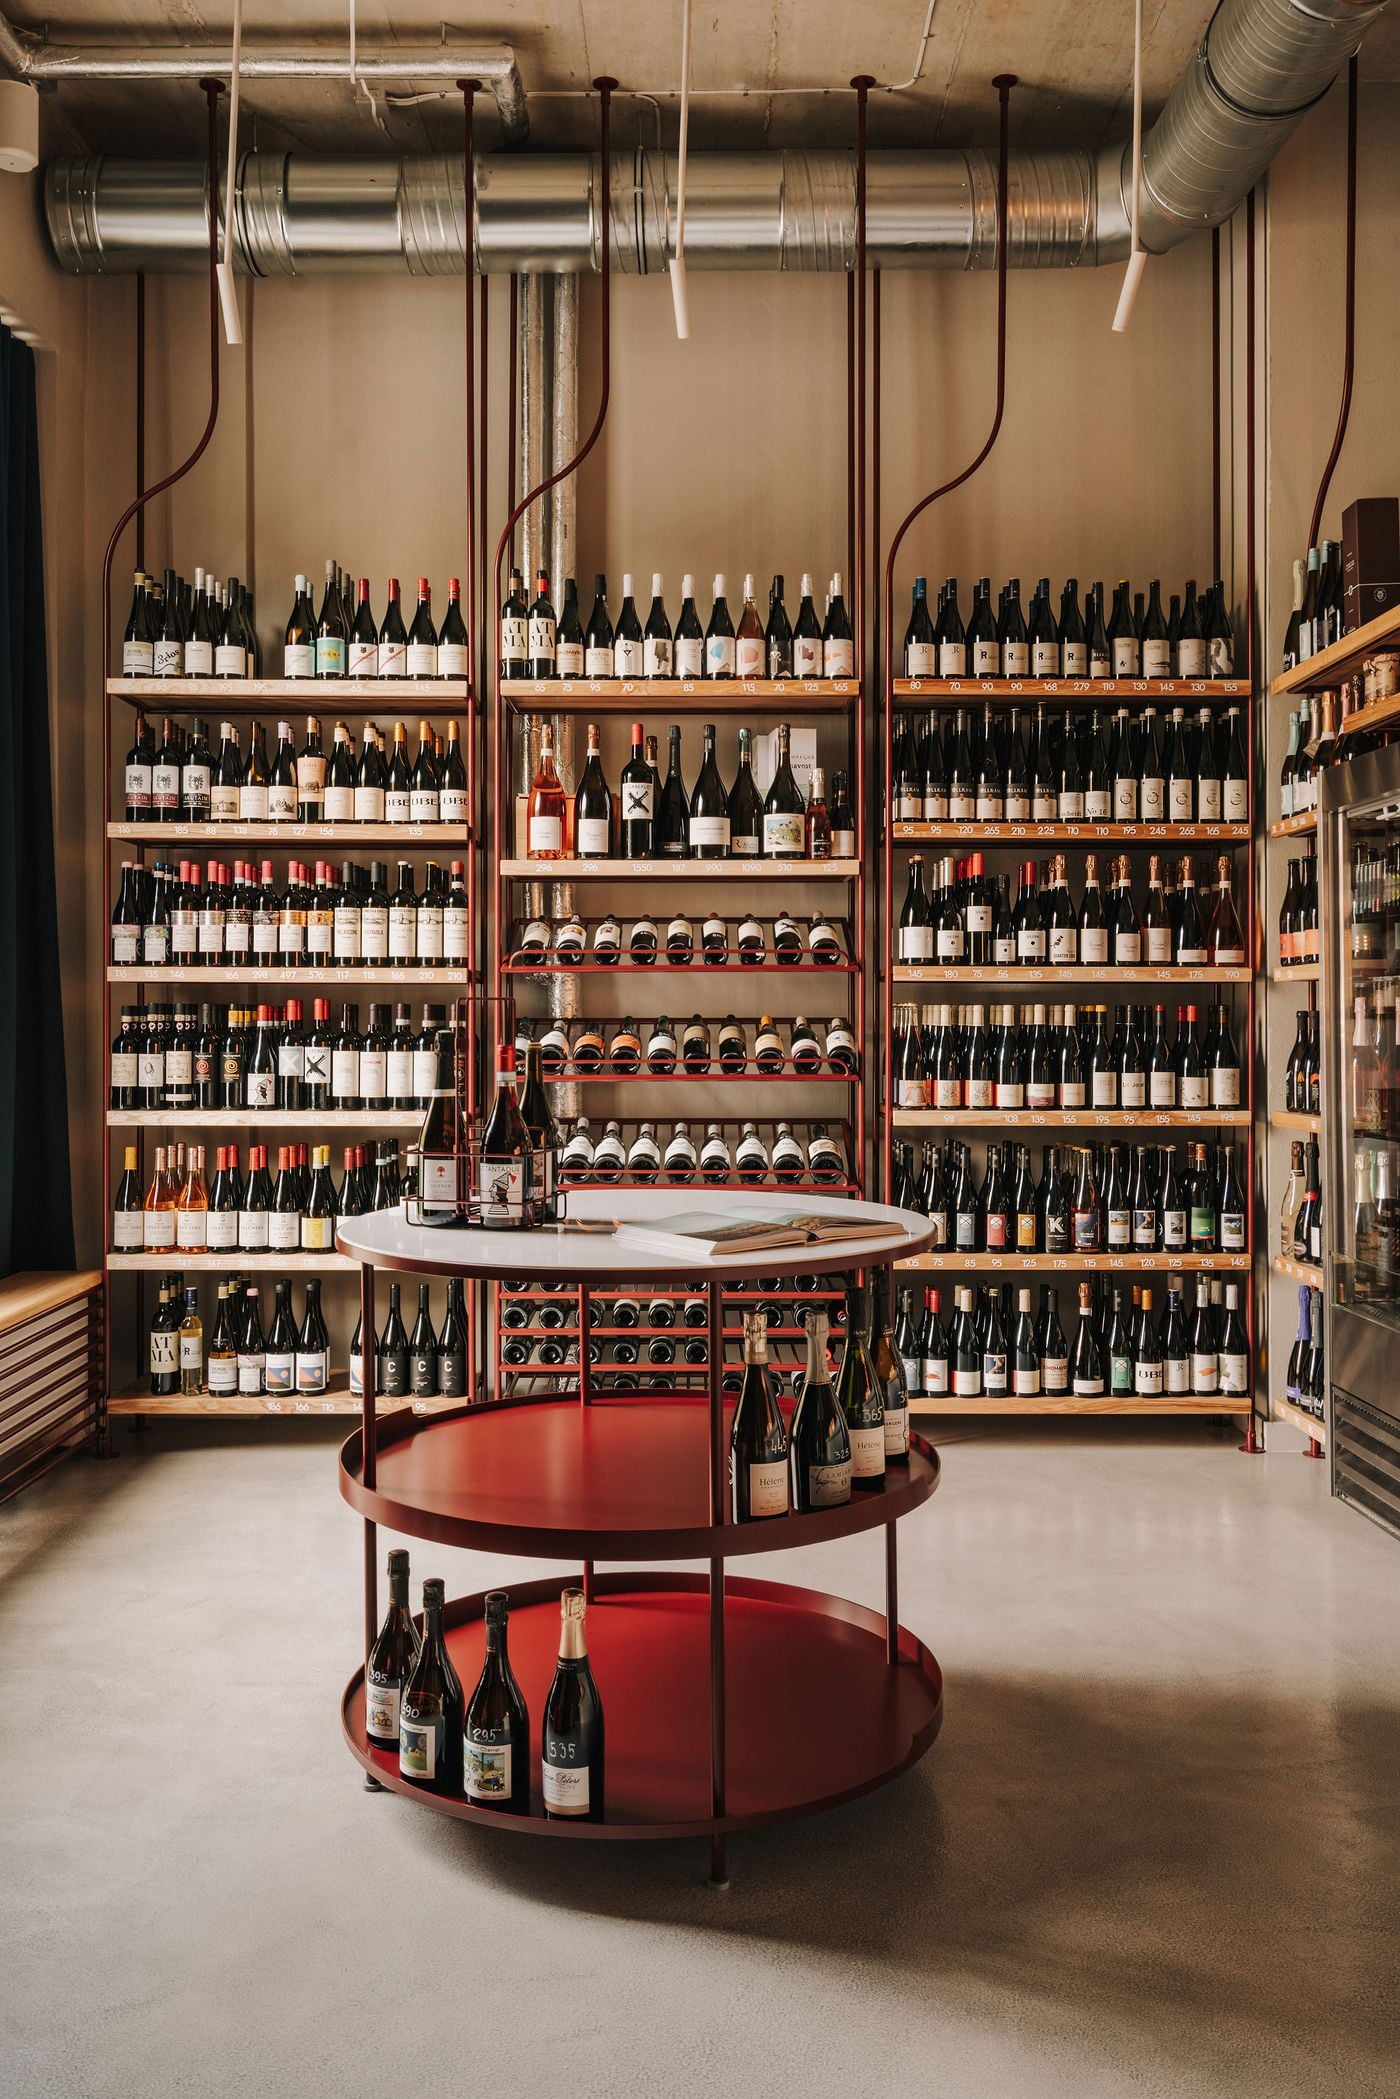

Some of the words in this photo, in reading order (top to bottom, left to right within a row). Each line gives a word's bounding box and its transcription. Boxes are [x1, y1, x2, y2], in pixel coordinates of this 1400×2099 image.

[157, 648, 181, 665] 3rios
[535, 684, 546, 692] 65
[562, 684, 573, 692] 75
[590, 684, 601, 692] 95
[622, 683, 633, 692] 70
[683, 683, 695, 692] 85
[742, 683, 756, 692] 115
[774, 683, 785, 692] 70
[804, 683, 819, 692] 125
[833, 683, 848, 692] 165
[910, 681, 922, 690] 80
[950, 682, 961, 690] 70
[982, 683, 993, 691] 90
[1011, 682, 1023, 691] 90
[1043, 683, 1058, 692] 168
[1073, 682, 1090, 691] 279
[1102, 682, 1115, 691] 110
[1132, 682, 1147, 691] 130
[1159, 683, 1174, 692] 145
[1190, 683, 1205, 692] 130
[1223, 683, 1238, 692] 155
[268, 827, 279, 836] 76
[292, 827, 307, 836] 127
[319, 827, 335, 836] 156
[408, 827, 423, 836] 135
[903, 826, 914, 835] 95
[931, 826, 942, 835] 95
[959, 826, 974, 835] 120
[984, 826, 1000, 835] 265
[1011, 826, 1026, 835] 210
[1038, 826, 1055, 835] 225
[1067, 826, 1080, 835] 110
[1095, 827, 1109, 836] 110
[1122, 826, 1137, 835] 195
[1149, 826, 1167, 835] 245
[1179, 826, 1195, 835] 265
[1206, 826, 1220, 835] 165
[1231, 826, 1249, 835] 245
[536, 863, 553, 872] 296
[582, 863, 598, 872] 296
[632, 863, 653, 872] 1550
[672, 863, 685, 872] 187
[706, 863, 723, 872] 990
[742, 863, 762, 872] 1090
[778, 863, 793, 872] 510
[823, 863, 838, 872] 125
[280, 971, 297, 980] 497
[309, 971, 324, 980] 576
[336, 971, 350, 980] 117
[419, 971, 434, 980] 210
[447, 972, 463, 981] 210
[909, 969, 923, 978] 145
[944, 970, 959, 979] 180
[973, 970, 983, 978] 75
[998, 970, 1009, 979] 55
[1029, 970, 1043, 979] 135
[1058, 970, 1073, 978] 145
[1155, 970, 1171, 979] 145
[1189, 970, 1204, 979] 175
[1224, 970, 1239, 979] 190
[944, 1115, 955, 1123] 98
[1005, 1115, 1019, 1123] 108
[1032, 1115, 1046, 1124] 135
[1063, 1115, 1077, 1124] 155
[1095, 1115, 1110, 1124] 195
[1123, 1115, 1135, 1125] 95
[1156, 1115, 1170, 1124] 155
[1186, 1114, 1201, 1123] 145
[1220, 1114, 1234, 1123] 195
[1049, 1217, 1065, 1233] K
[905, 1258, 920, 1267] 105
[933, 1257, 944, 1266] 75
[965, 1259, 976, 1268] 85
[992, 1258, 1003, 1267] 95
[1023, 1258, 1037, 1267] 125
[1053, 1259, 1068, 1268] 175
[1084, 1258, 1096, 1267] 115
[1109, 1258, 1123, 1267] 145
[1140, 1258, 1155, 1267] 120
[1168, 1258, 1182, 1267] 125
[1200, 1258, 1214, 1267] 135
[1230, 1258, 1245, 1267] 145
[152, 1336, 173, 1349] AT
[151, 1349, 175, 1362] MA
[388, 1361, 396, 1373] C
[418, 1361, 426, 1372] C
[444, 1361, 453, 1372] C
[295, 1403, 310, 1412] 166
[322, 1403, 335, 1412] 110
[415, 1403, 427, 1412] 95
[862, 1407, 884, 1423] 365
[770, 1436, 787, 1454] 445
[834, 1447, 850, 1461] 325
[369, 1670, 389, 1684] 395
[472, 1728, 499, 1743] 295
[549, 1741, 576, 1759] 535
